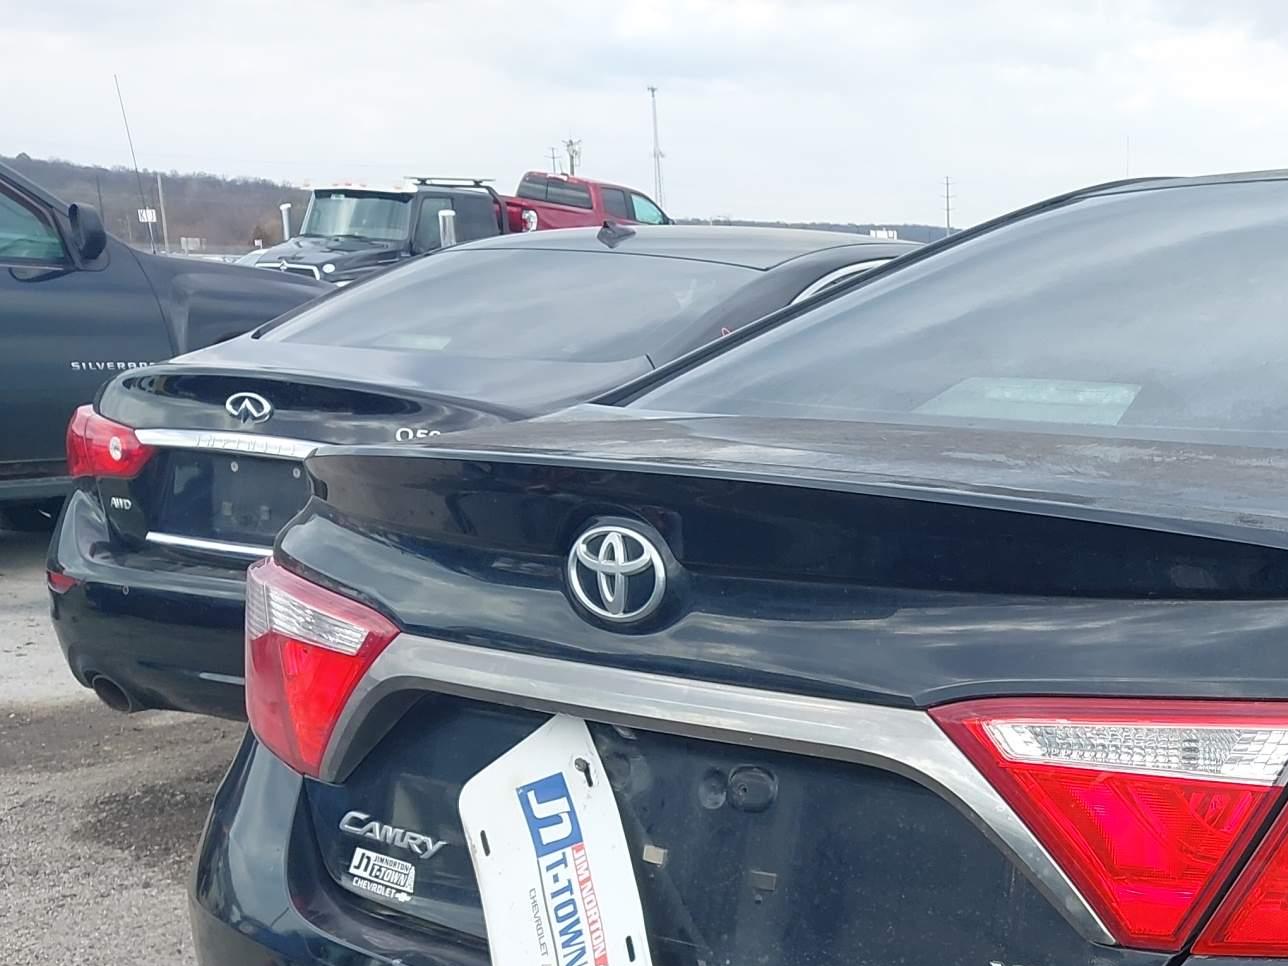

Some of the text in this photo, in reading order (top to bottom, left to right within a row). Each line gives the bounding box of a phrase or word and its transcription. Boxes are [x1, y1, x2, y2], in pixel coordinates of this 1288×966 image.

[111, 496, 132, 510] AWD
[339, 811, 448, 859] CAMRY
[352, 876, 397, 899] CHEVROLET
[371, 864, 408, 887] T-TOWN
[573, 848, 607, 959] JIM NORTON
[529, 887, 549, 957] CHEVROLET
